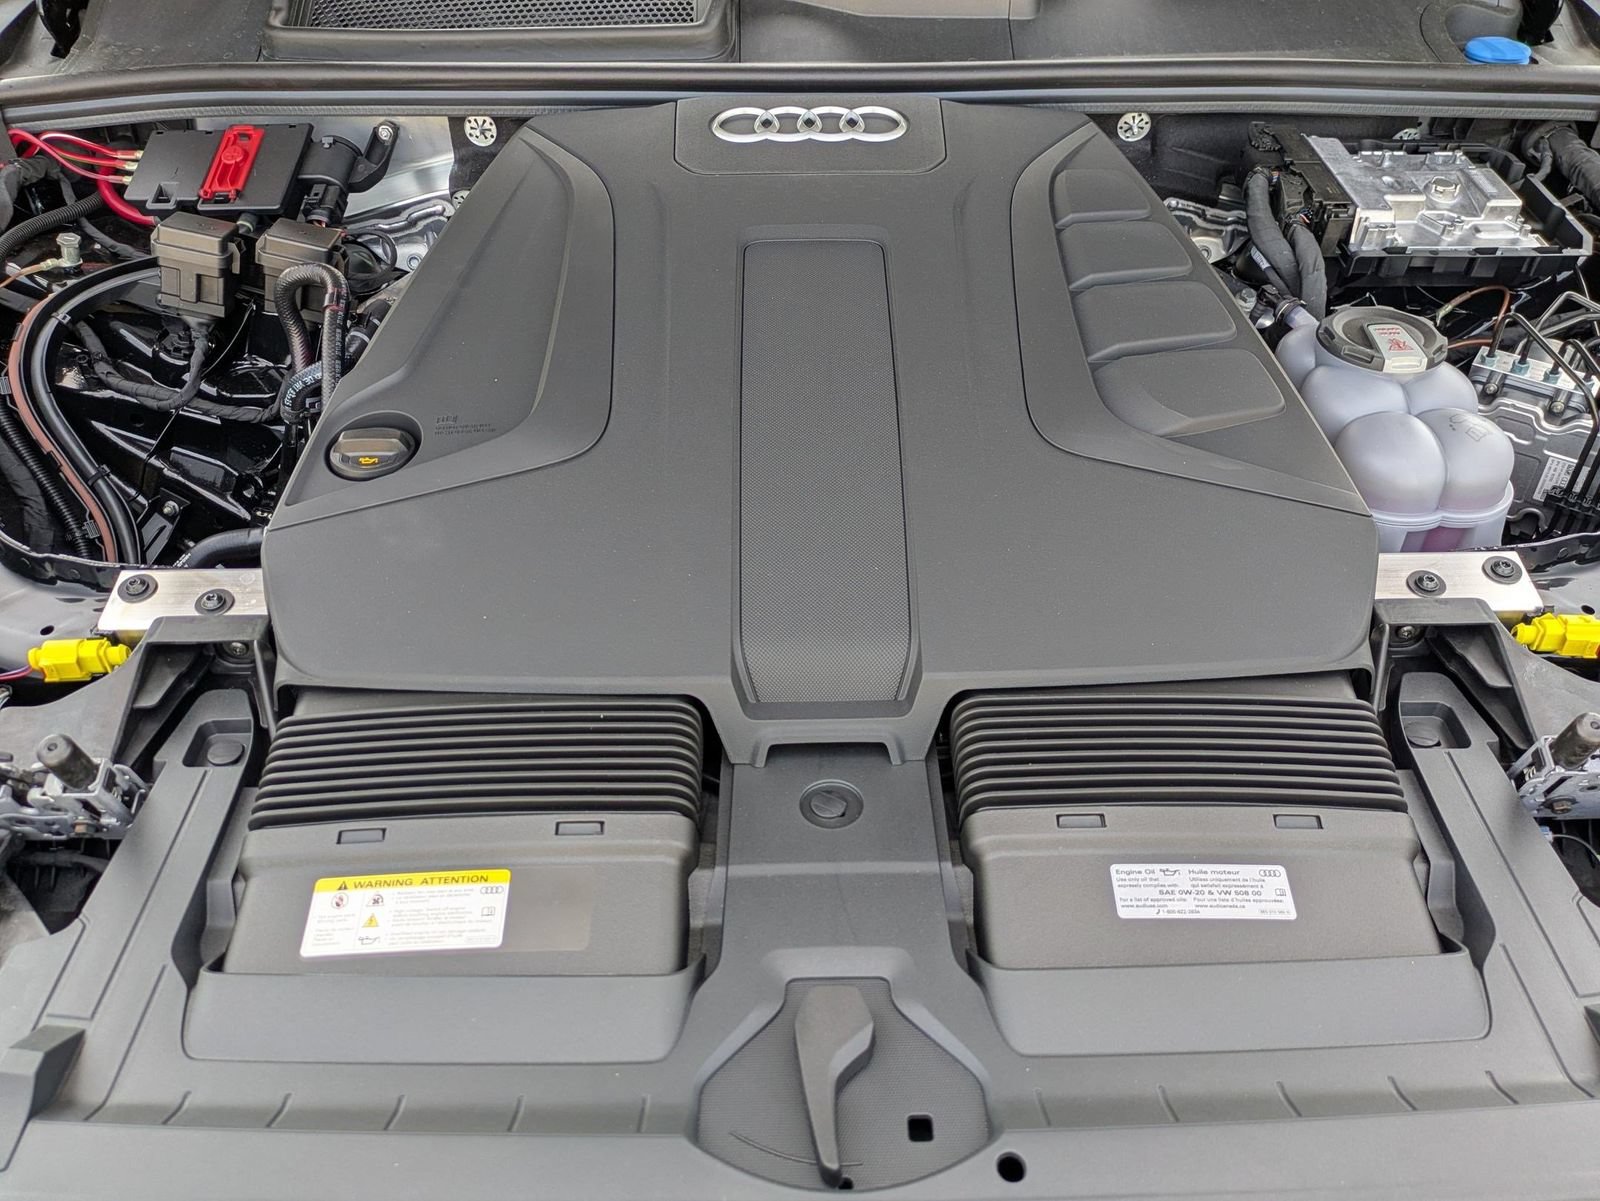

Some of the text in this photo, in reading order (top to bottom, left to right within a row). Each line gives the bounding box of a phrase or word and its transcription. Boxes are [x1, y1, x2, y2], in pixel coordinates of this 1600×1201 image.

[1115, 868, 1143, 876] Engine
[353, 874, 489, 889] WARNING ATTENTION
